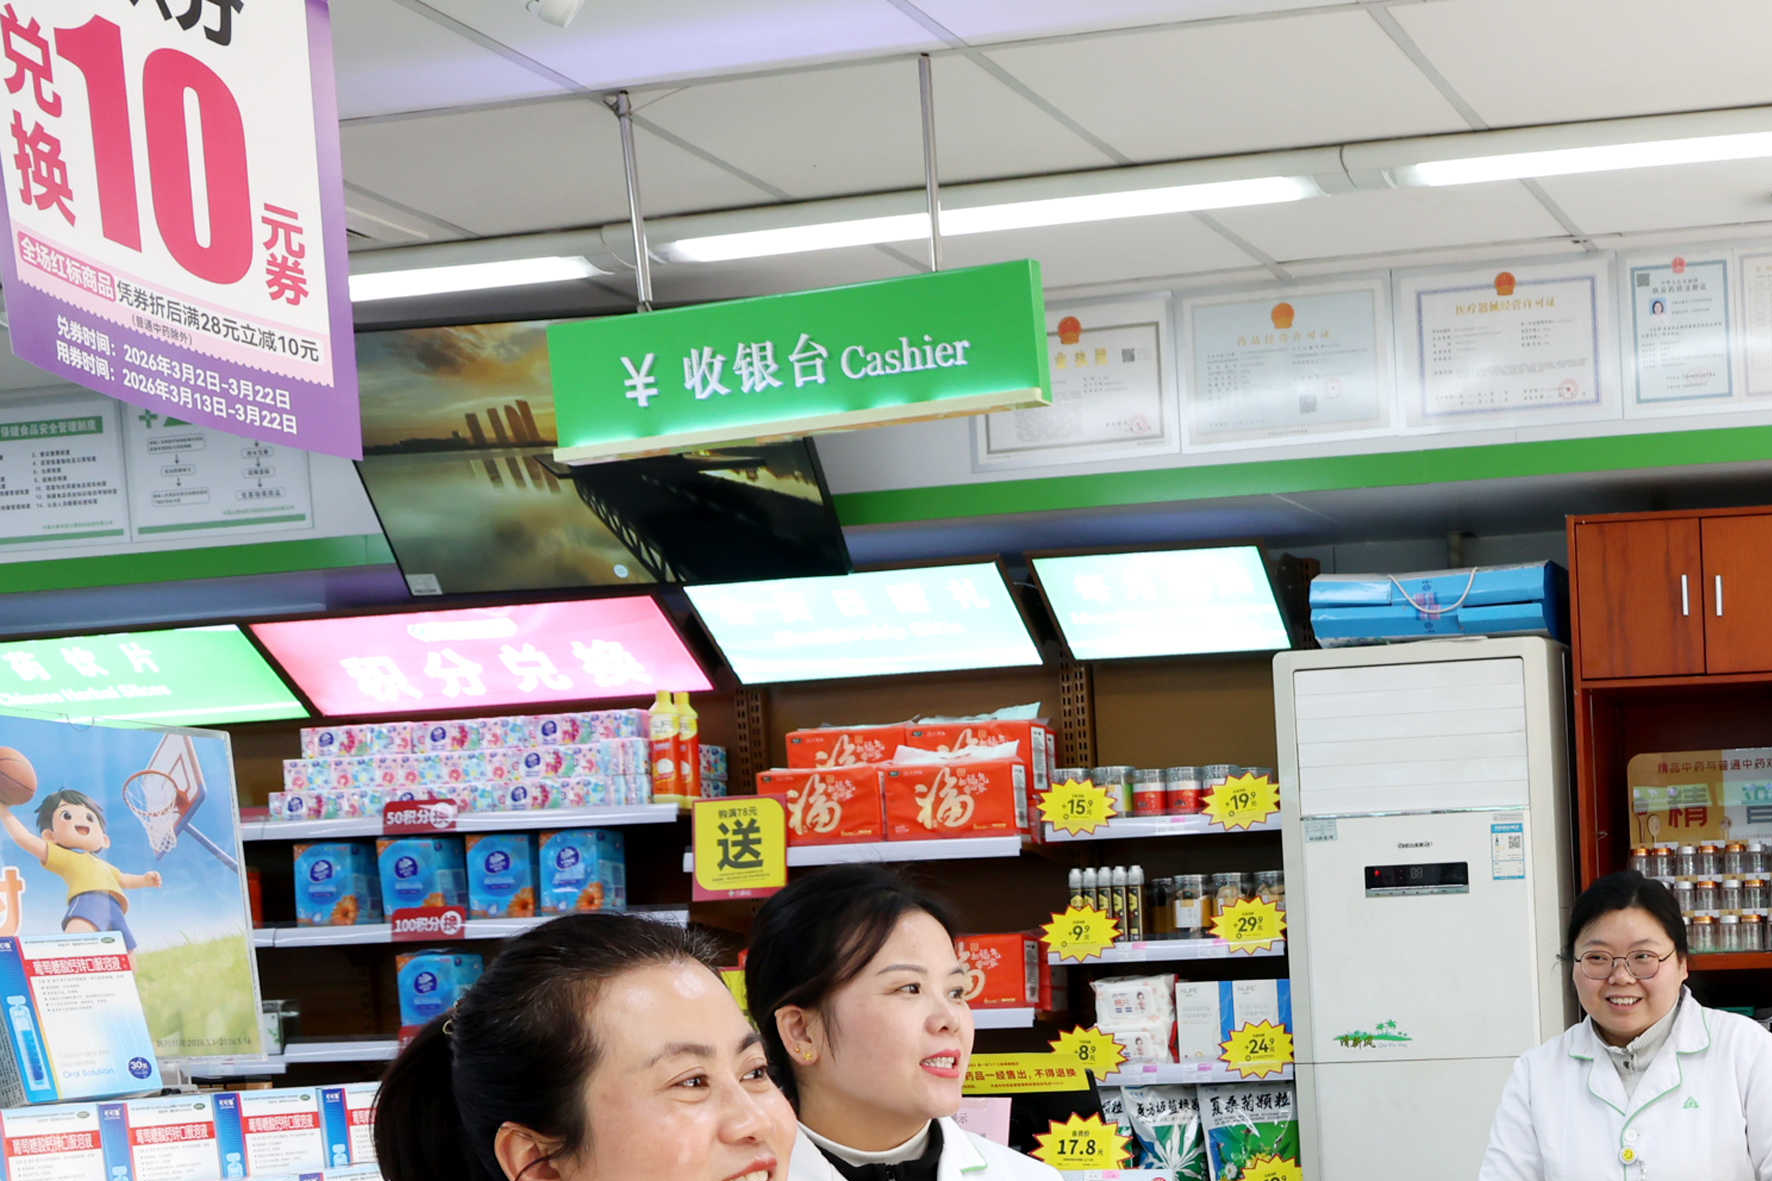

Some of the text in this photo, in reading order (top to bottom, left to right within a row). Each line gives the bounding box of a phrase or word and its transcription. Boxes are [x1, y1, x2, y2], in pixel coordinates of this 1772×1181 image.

[0, 2, 76, 227] 兑换
[53, 14, 254, 286] 10
[20, 237, 321, 363] 全场红标商品 凭券折后满28元立减10元
[261, 202, 310, 308] 元券
[683, 333, 971, 400] 收银台 Cashier
[340, 640, 653, 698] 积分兑换
[716, 818, 764, 872] 送
